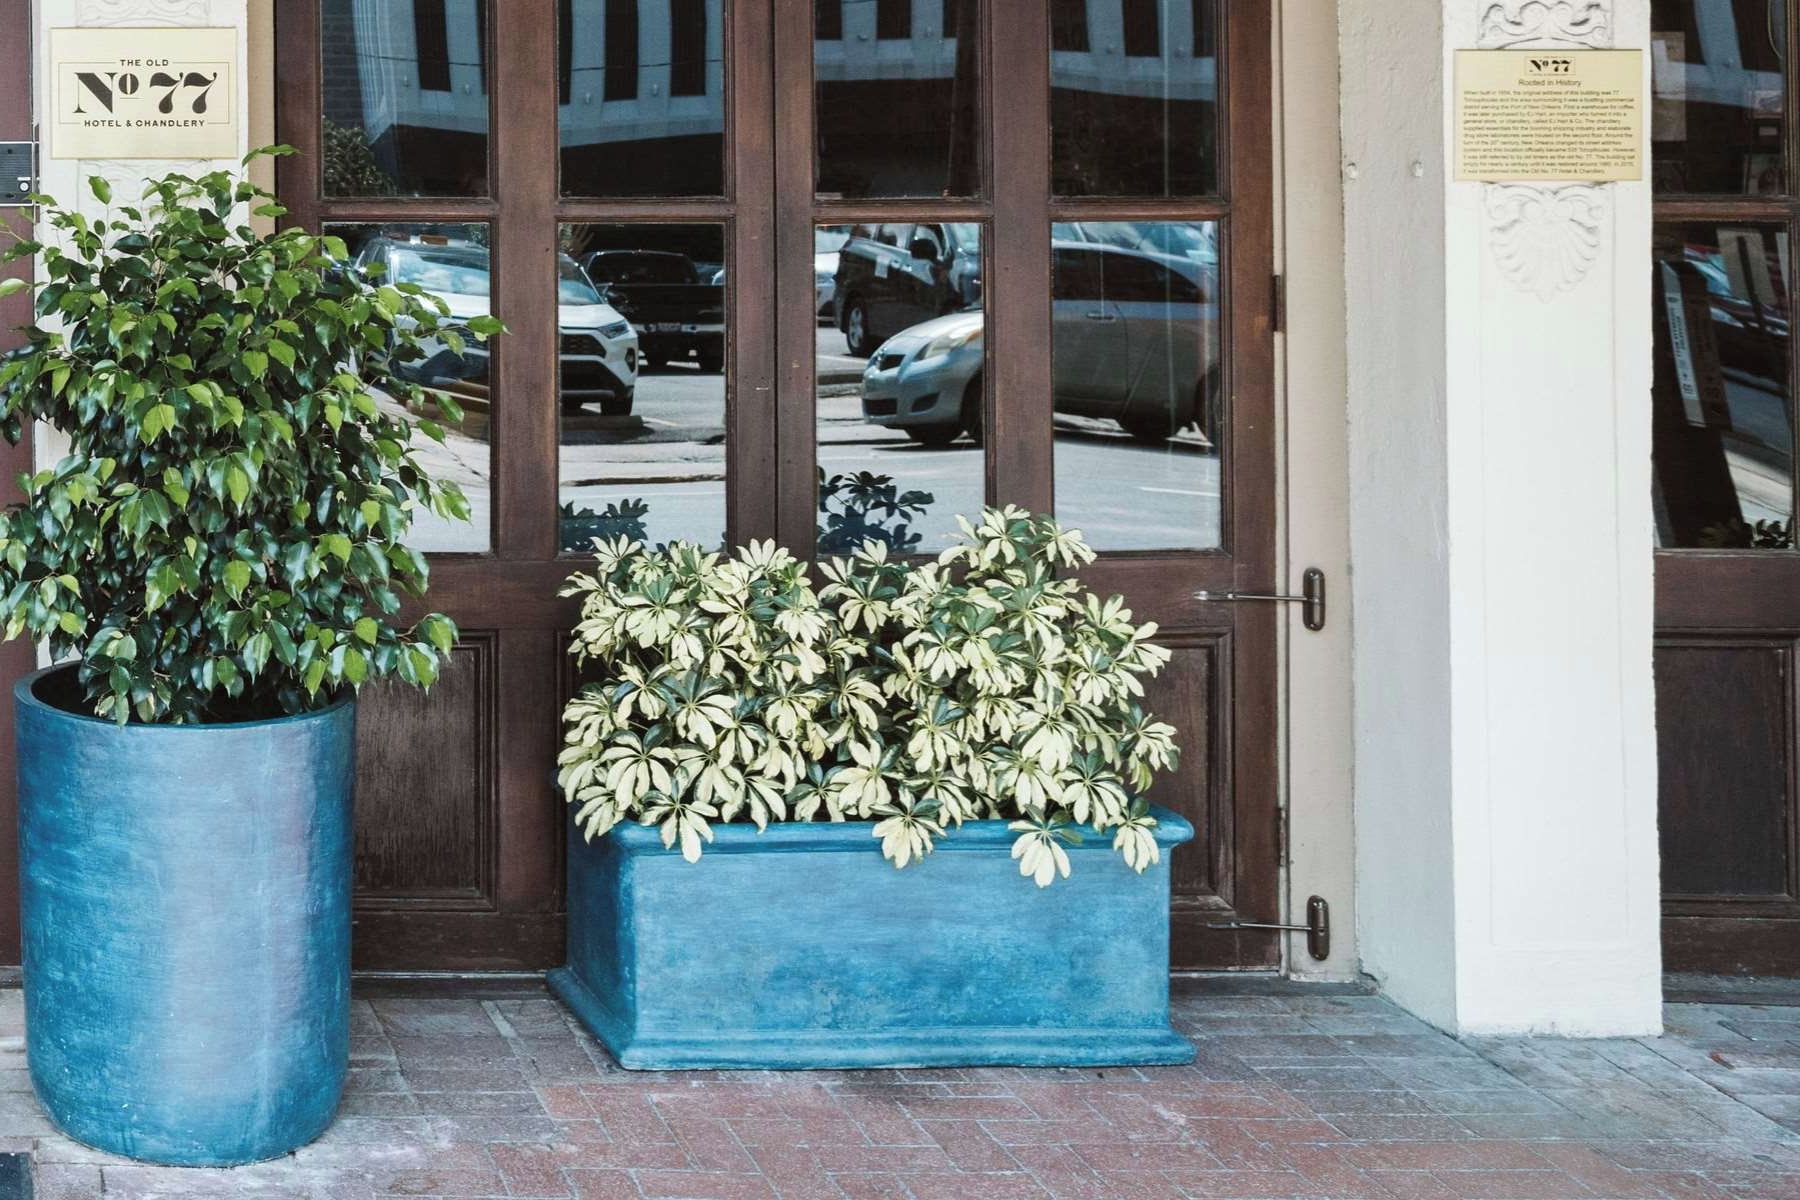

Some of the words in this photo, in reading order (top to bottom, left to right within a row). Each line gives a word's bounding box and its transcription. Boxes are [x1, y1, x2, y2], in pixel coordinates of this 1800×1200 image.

[120, 59, 141, 67] THE
[146, 59, 169, 67] OLD
[1551, 59, 1572, 72] 77
[149, 72, 217, 114] 77
[84, 120, 121, 128] HOTEL
[135, 120, 205, 128] CHANDLERY
